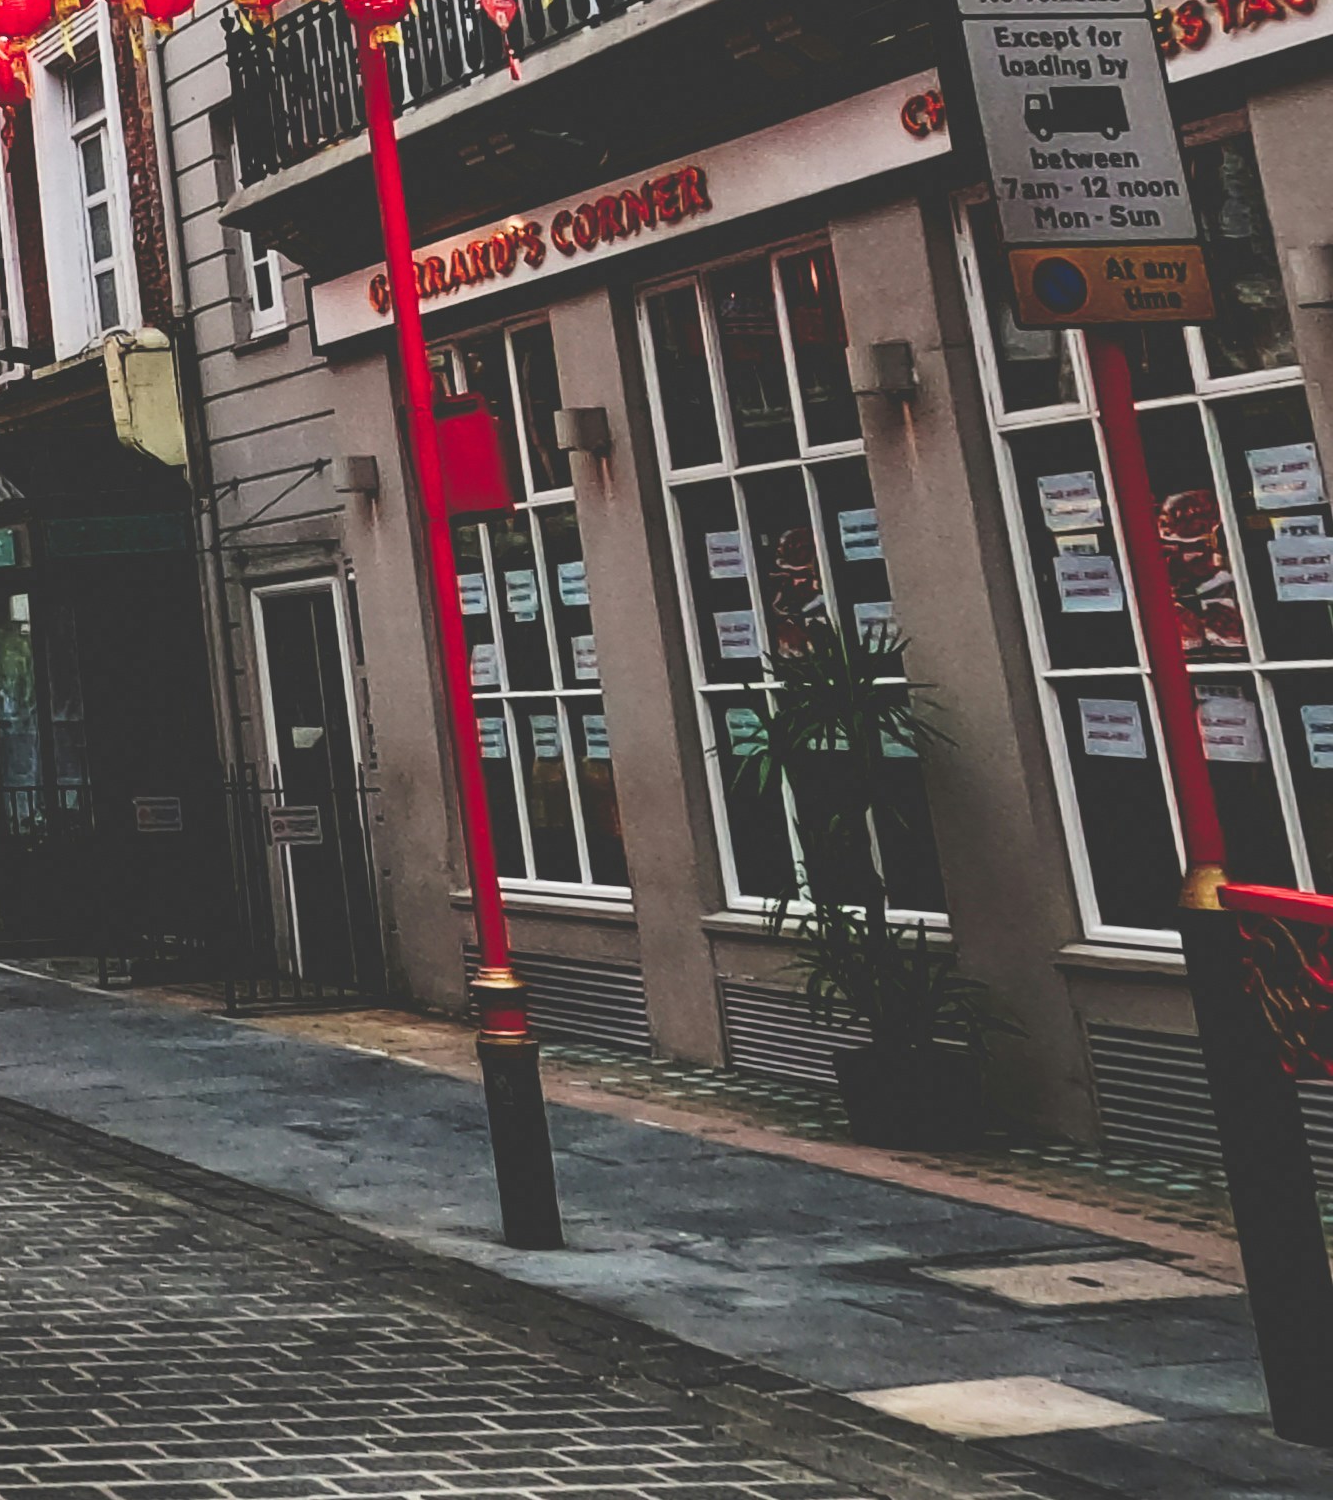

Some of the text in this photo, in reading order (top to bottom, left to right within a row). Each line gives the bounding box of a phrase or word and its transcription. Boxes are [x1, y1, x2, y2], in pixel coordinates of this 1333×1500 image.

[994, 26, 1122, 51] Except for
[999, 55, 1129, 80] loading by
[1031, 147, 1140, 171] between
[1001, 177, 1060, 200] 7am
[1081, 177, 1110, 199] 12
[1117, 178, 1180, 199] noon
[1034, 206, 1089, 229] Mon
[1110, 205, 1162, 228] Sun
[369, 164, 713, 315] GRRARD'S CORNER
[1106, 257, 1188, 285] At any
[1123, 288, 1183, 311] time
